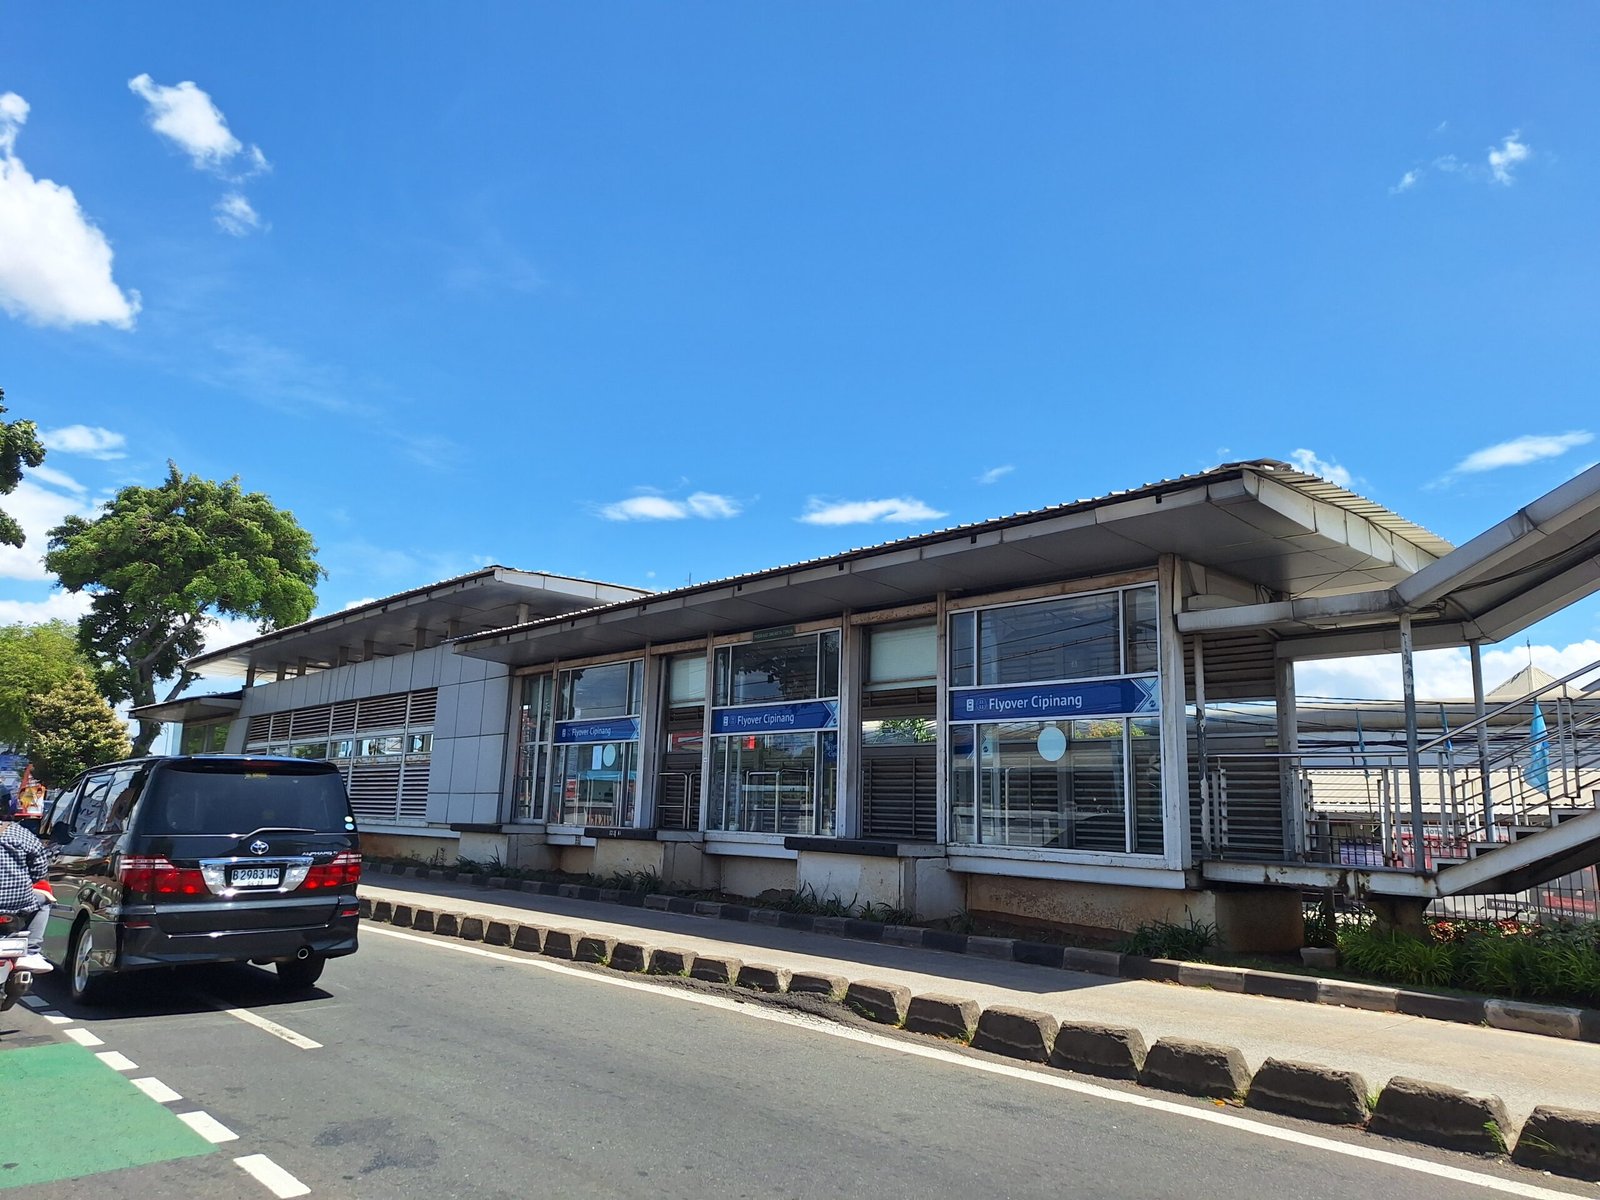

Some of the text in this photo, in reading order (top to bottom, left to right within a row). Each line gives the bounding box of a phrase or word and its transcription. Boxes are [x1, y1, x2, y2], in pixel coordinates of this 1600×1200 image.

[989, 695, 1083, 712] Flyover Cipinang
[737, 714, 795, 727] Flyover Cipinang
[571, 727, 612, 737] Flyover Cipinang
[232, 868, 279, 881] B 2983 WS
